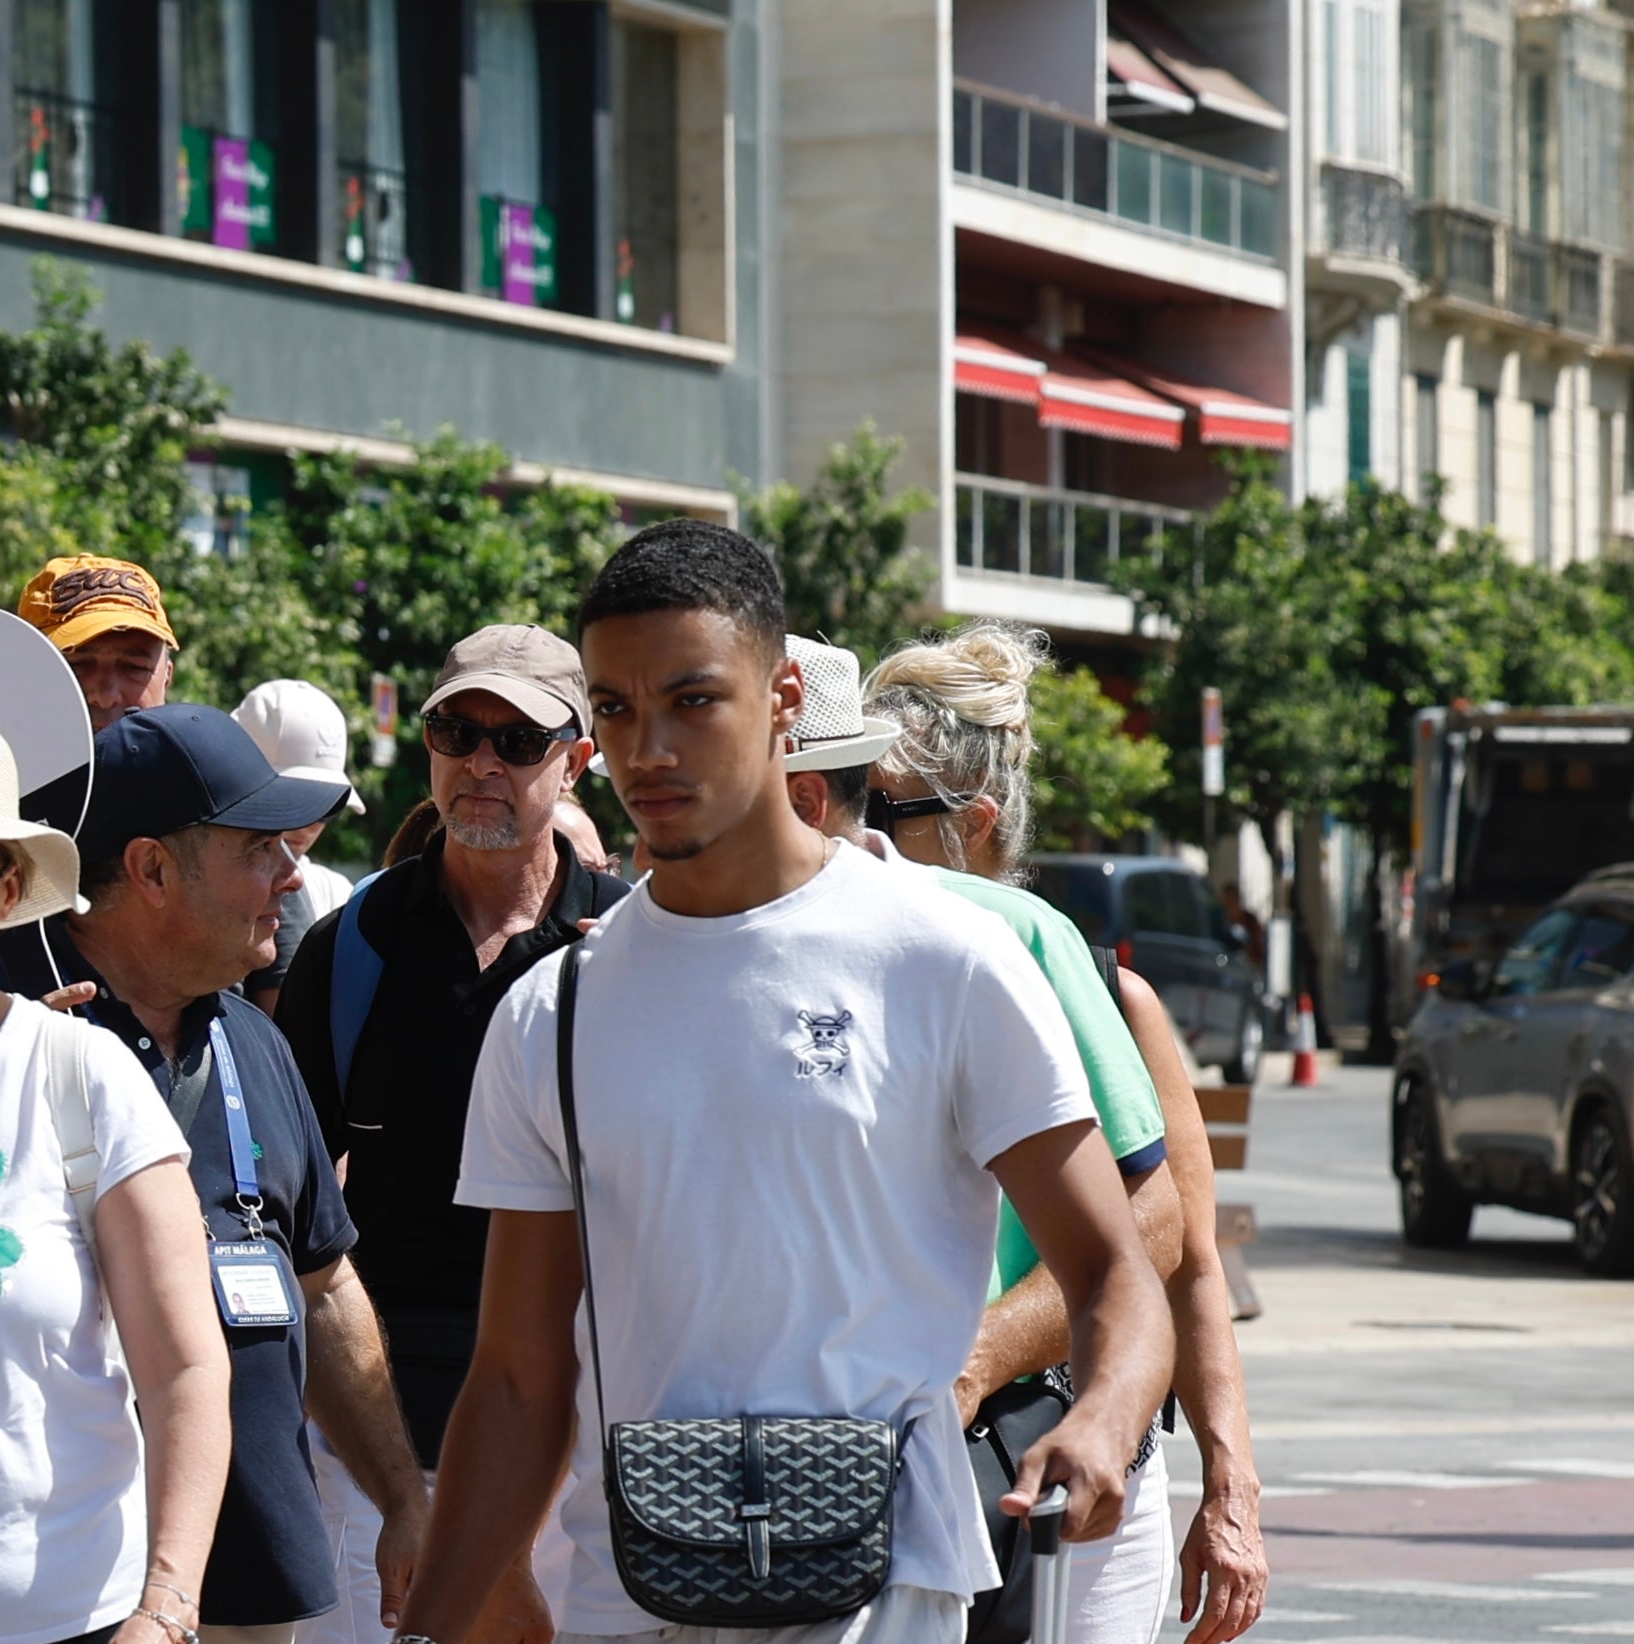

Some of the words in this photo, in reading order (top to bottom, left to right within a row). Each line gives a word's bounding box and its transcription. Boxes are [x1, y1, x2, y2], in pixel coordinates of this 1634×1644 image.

[797, 1060, 847, 1076] ルフィ
[214, 1245, 231, 1255] APIT
[232, 1243, 268, 1255] MÁLAGA
